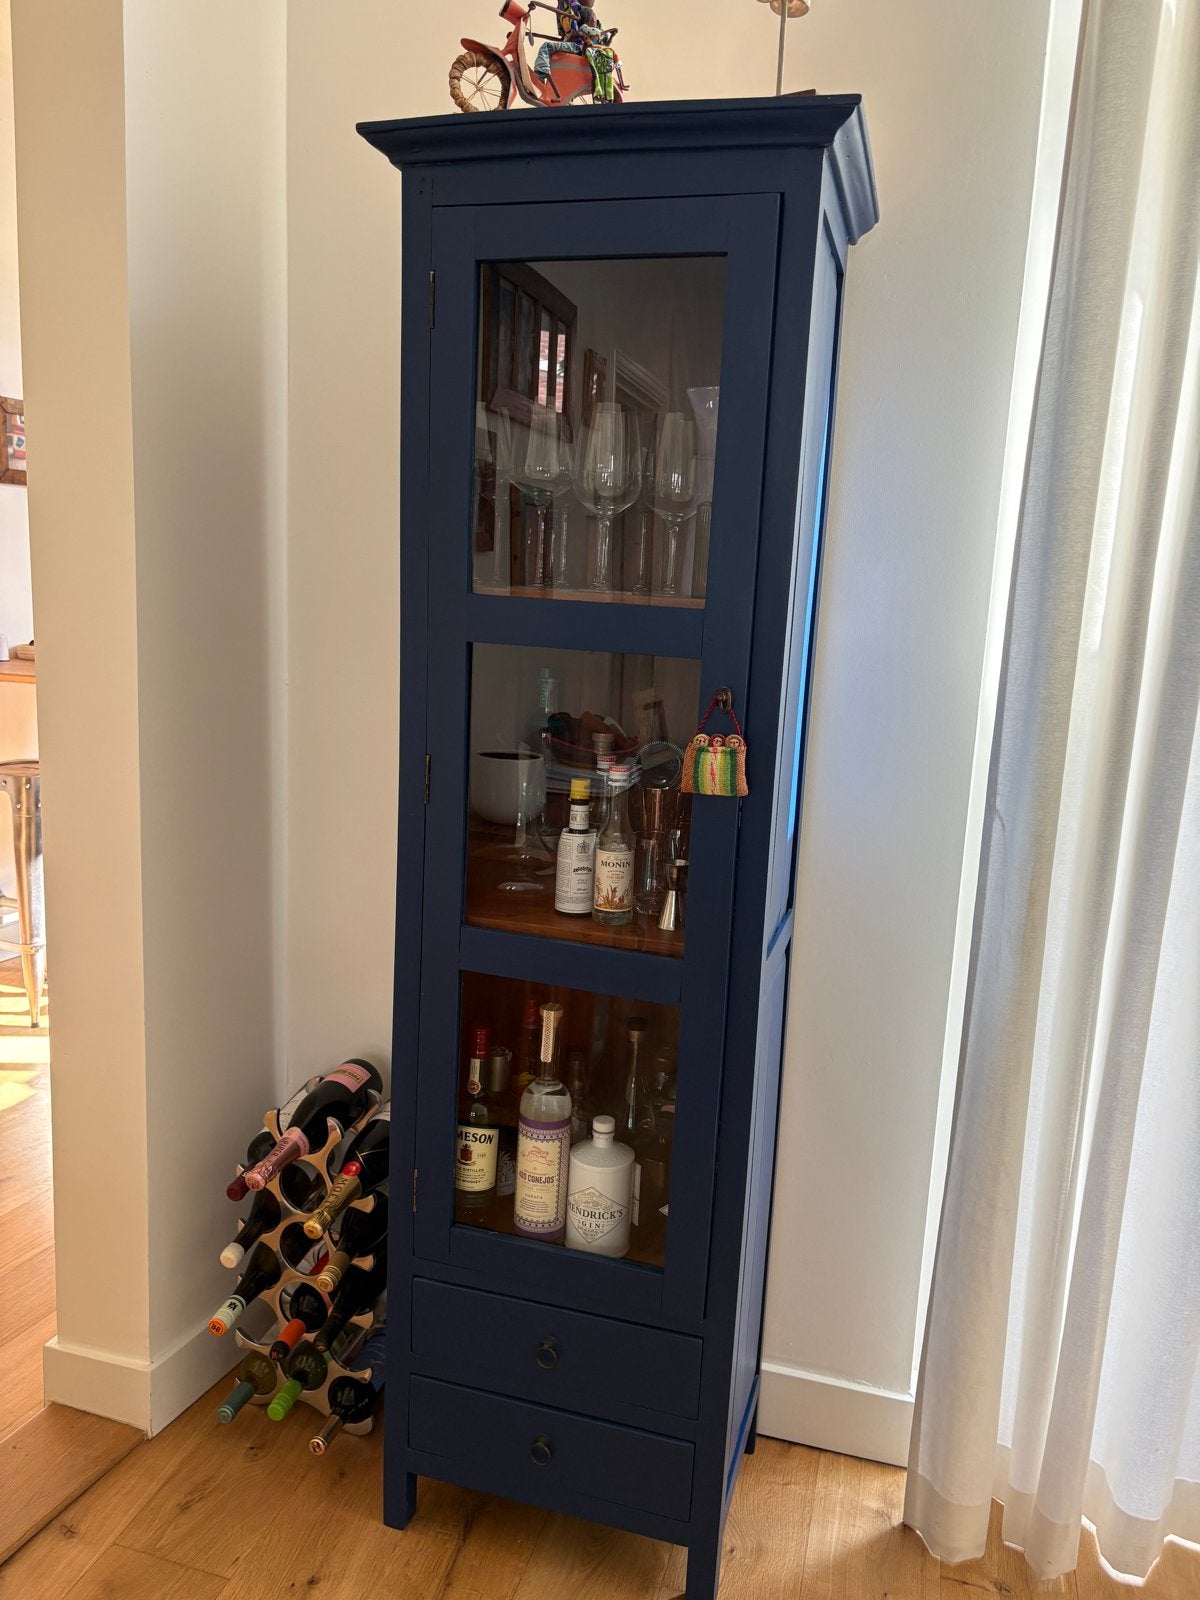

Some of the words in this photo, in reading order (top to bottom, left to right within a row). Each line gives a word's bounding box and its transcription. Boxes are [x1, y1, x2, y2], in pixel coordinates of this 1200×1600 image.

[600, 860, 631, 868] MONIN
[527, 1174, 555, 1184] CONEJOS
[567, 1200, 624, 1220] HENDRICK'S
[581, 1220, 601, 1229] GIN
